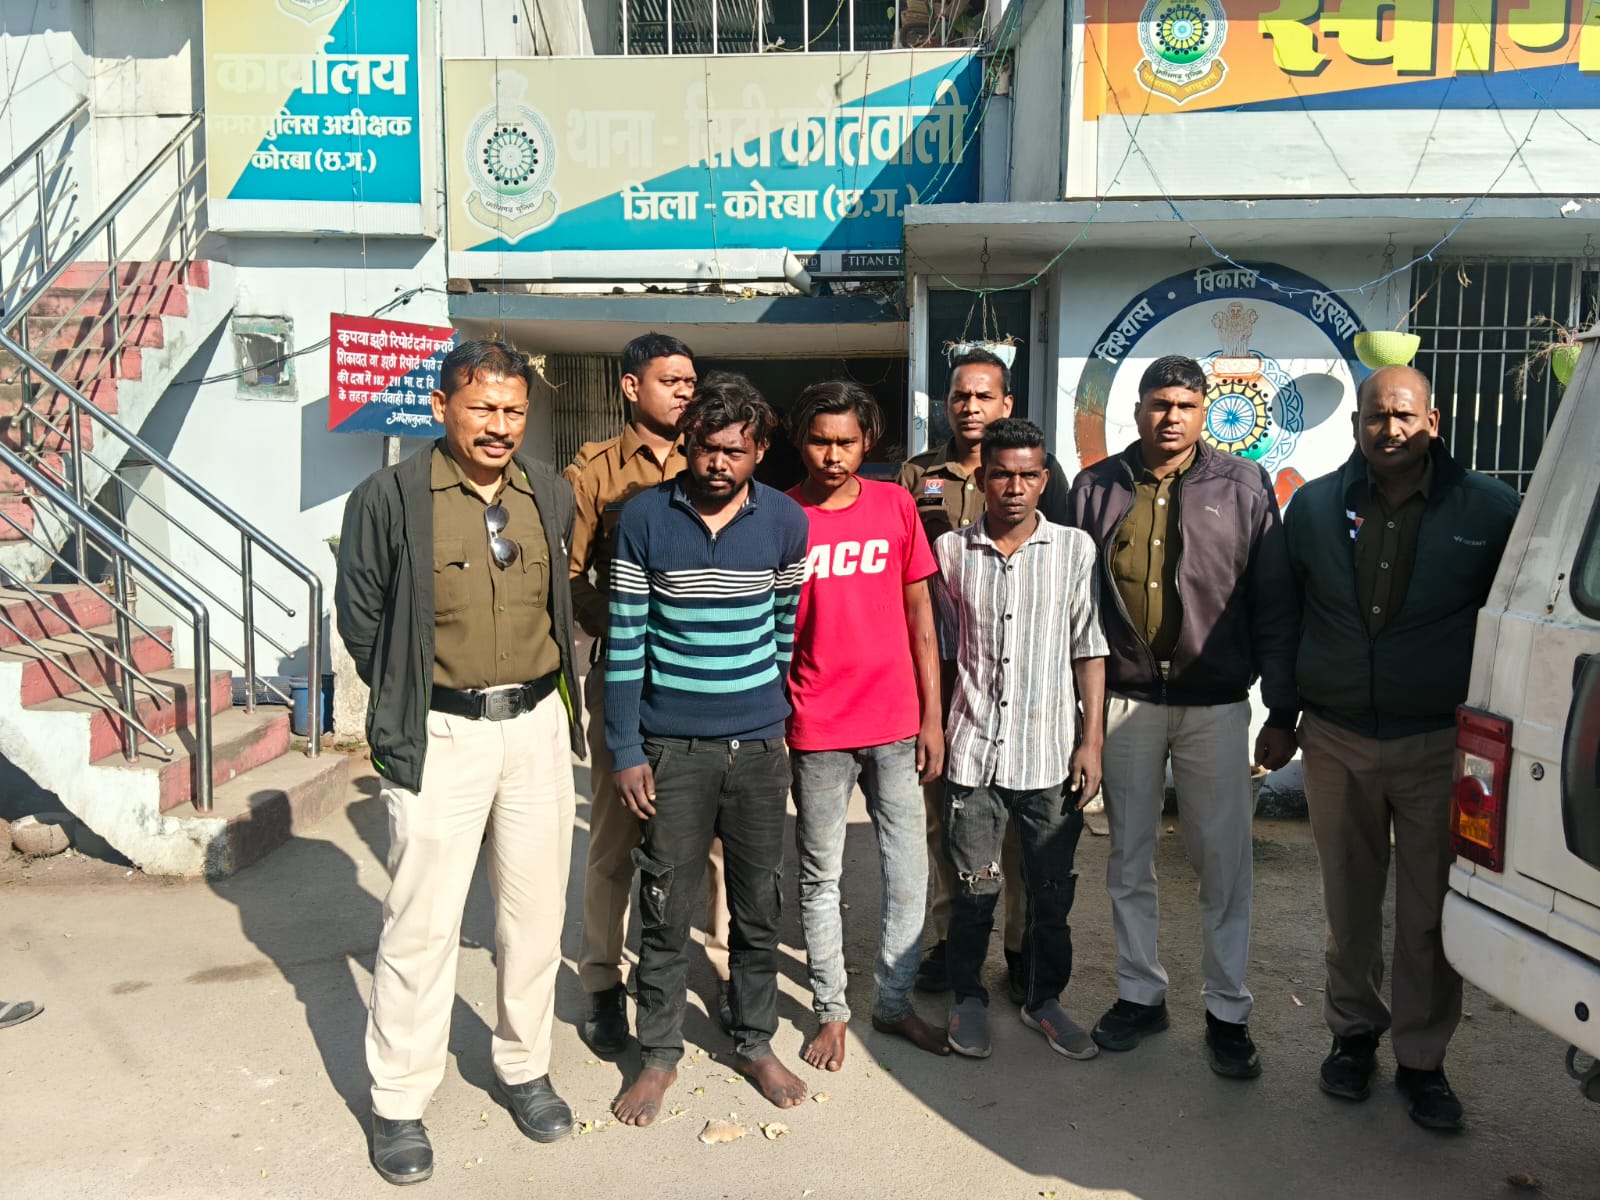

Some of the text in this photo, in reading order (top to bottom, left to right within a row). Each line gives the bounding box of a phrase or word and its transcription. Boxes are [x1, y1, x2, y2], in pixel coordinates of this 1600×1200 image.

[213, 35, 409, 95] कार्यालय
[259, 107, 319, 141] पुलिस
[322, 108, 412, 138] अधीक्षक
[567, 108, 655, 169] थाना
[685, 82, 773, 169] सिटी
[779, 79, 968, 169] कोतवाली
[251, 144, 377, 174] कोरबा (छ.ग.)
[620, 184, 699, 221] जिला
[723, 179, 819, 220] कोरबा
[848, 256, 884, 266] TITAN
[1194, 267, 1261, 295] विकास
[1095, 298, 1155, 365] विश्वास
[1309, 291, 1359, 341] सुरक्षा
[337, 329, 369, 347] कृपया
[337, 369, 349, 384] की
[338, 386, 347, 401] के
[348, 390, 369, 403] तहत
[404, 390, 416, 405] की
[802, 539, 889, 583] ACC
